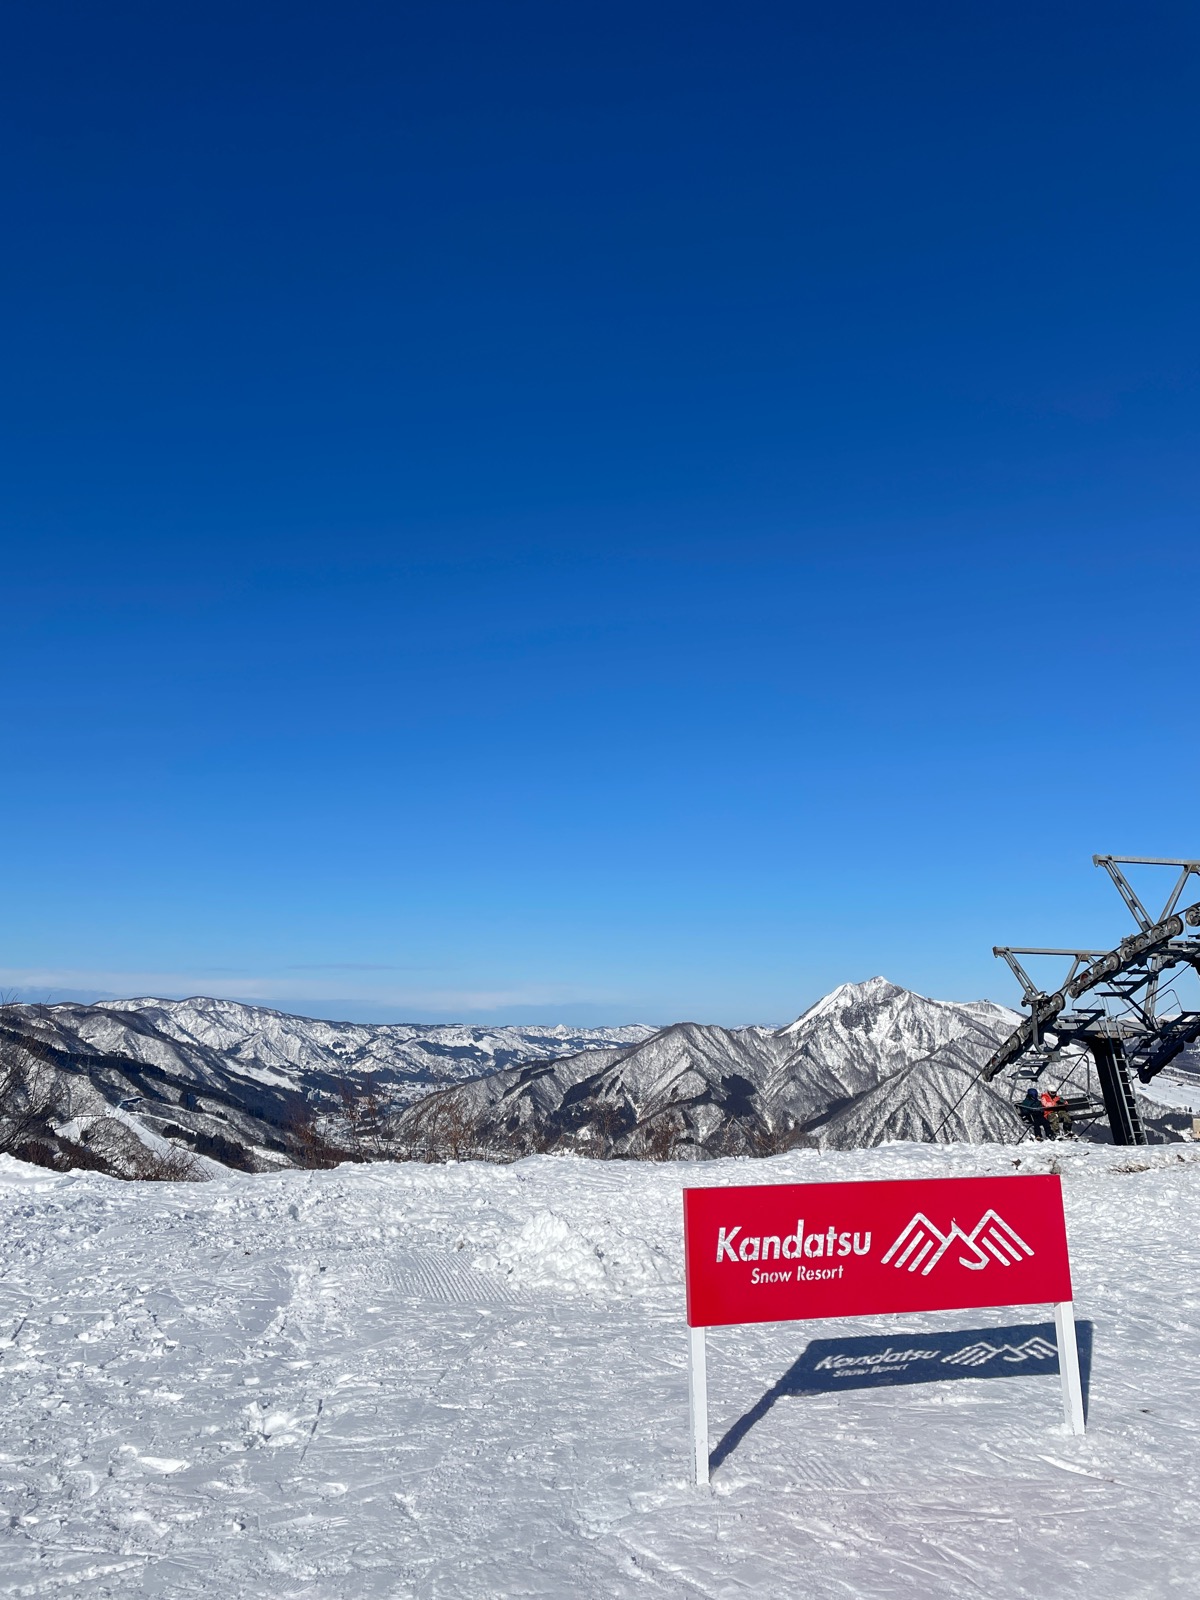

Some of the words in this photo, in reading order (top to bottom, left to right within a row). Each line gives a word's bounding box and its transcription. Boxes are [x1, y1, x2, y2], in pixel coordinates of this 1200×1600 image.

[715, 1219, 872, 1263] Kandatsu
[750, 1266, 792, 1285] Snow
[797, 1264, 844, 1281] Resort
[814, 1348, 941, 1371] Kandatsu
